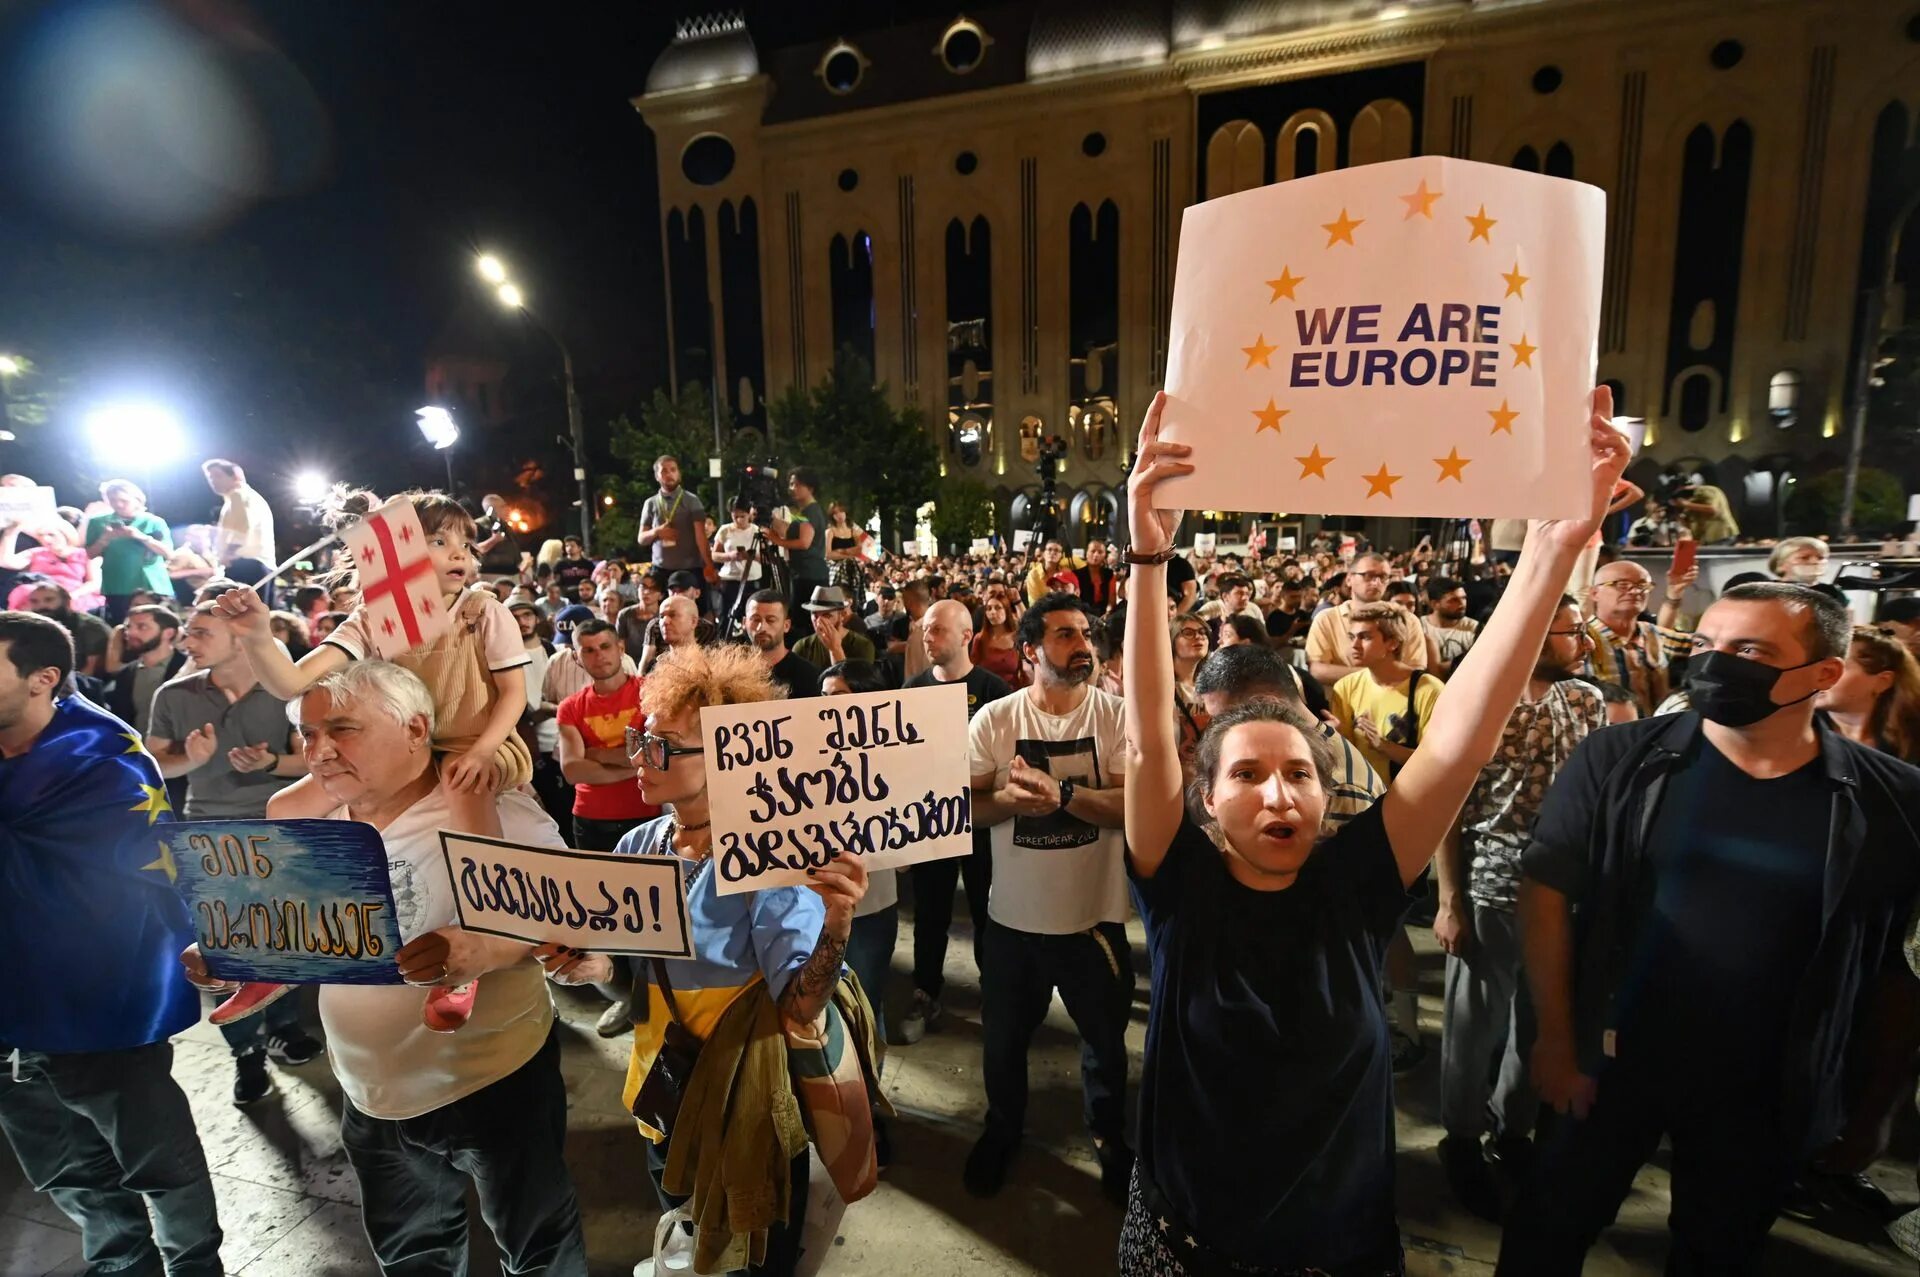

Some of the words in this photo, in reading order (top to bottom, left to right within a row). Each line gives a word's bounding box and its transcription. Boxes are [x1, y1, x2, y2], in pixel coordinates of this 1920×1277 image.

[1295, 304, 1382, 347] WE
[1397, 303, 1501, 344] ARE
[1290, 348, 1500, 388] EUROPE
[714, 715, 794, 771] ჩვენ
[818, 700, 919, 751] შენს
[189, 833, 273, 879] შინ
[1015, 834, 1074, 846] STREETWEAR
[198, 899, 385, 960] ევროპისაკენ
